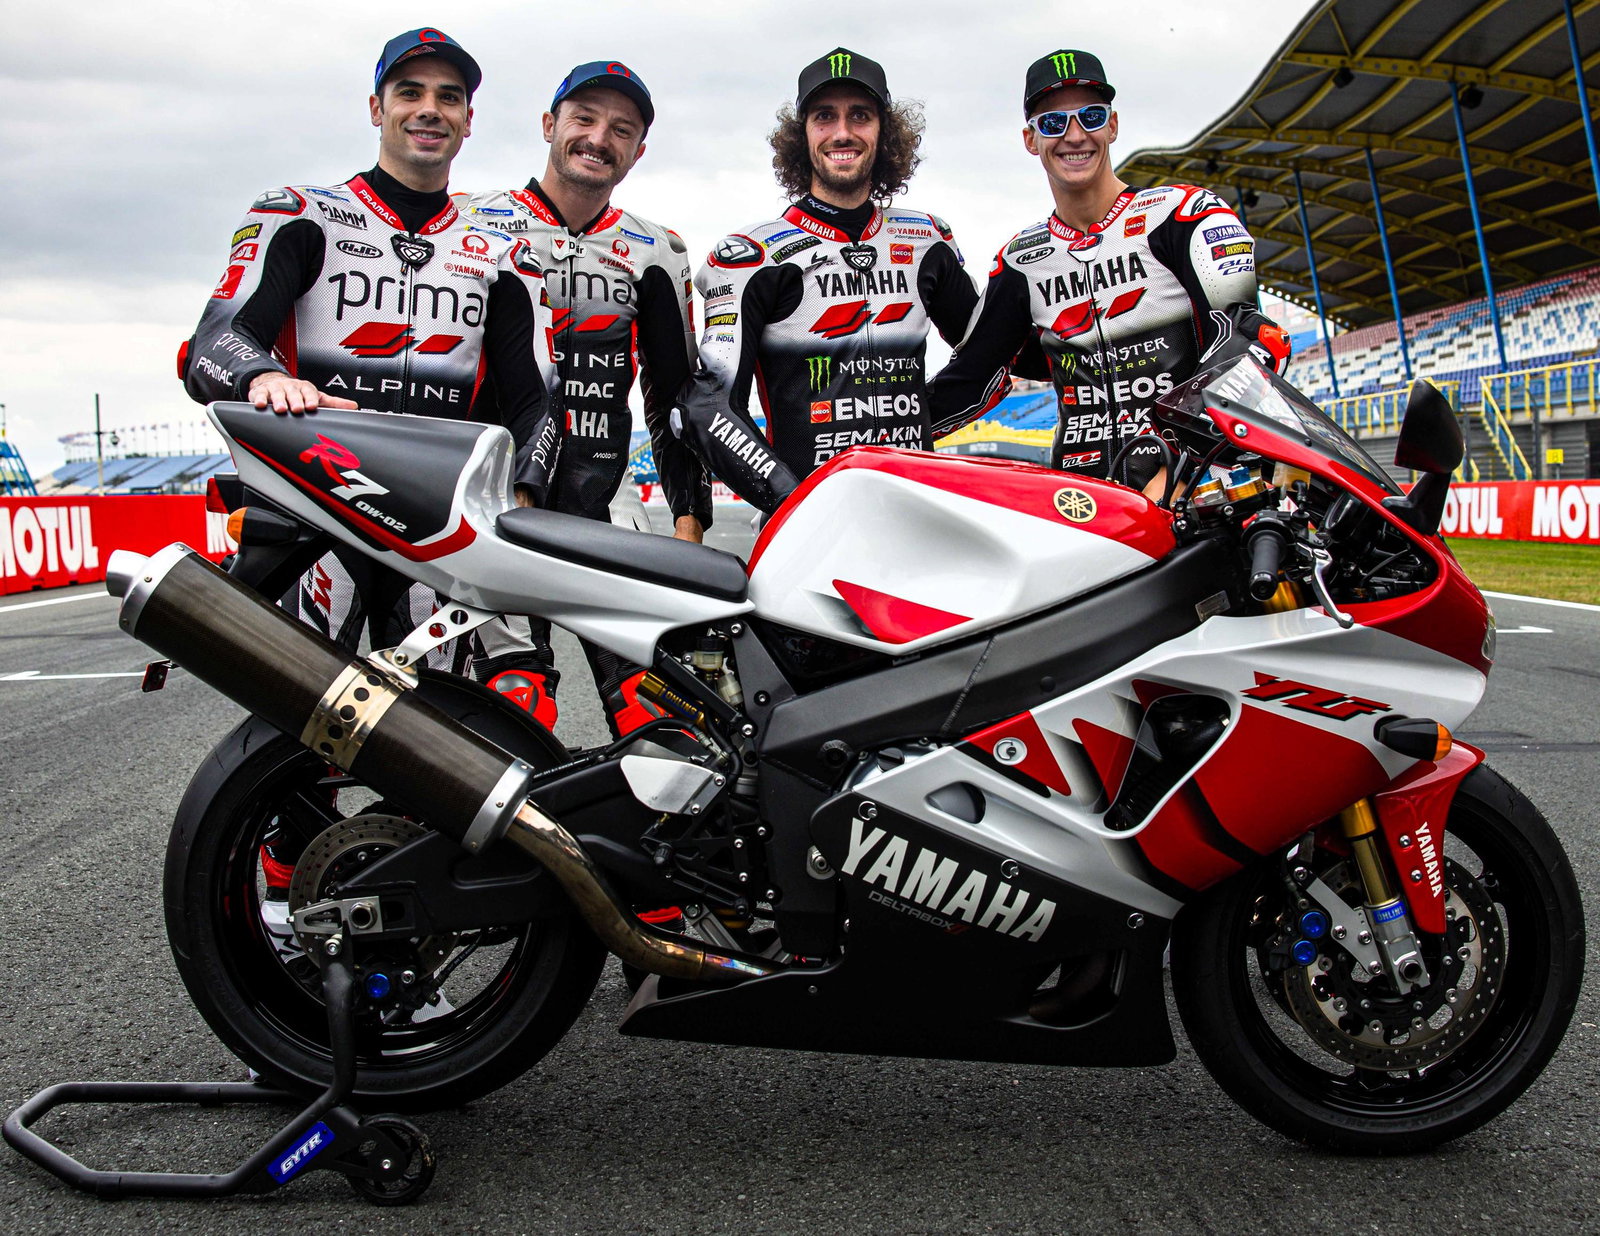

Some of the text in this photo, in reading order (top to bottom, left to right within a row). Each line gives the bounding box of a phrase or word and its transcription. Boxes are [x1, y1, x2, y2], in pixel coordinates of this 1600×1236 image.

[317, 201, 367, 229] FIAMM
[358, 188, 397, 224] PRAMAC
[1097, 196, 1130, 230] YAMAHA
[1135, 195, 1167, 208] YAMAHA
[487, 219, 529, 232] FIAMM
[799, 215, 837, 240] YAMAHA
[897, 227, 933, 238] YAMAHA
[1125, 222, 1145, 230] ENEOS
[341, 242, 378, 256] HJC
[451, 249, 497, 265] PRAMAC
[1021, 248, 1048, 262] HJC
[453, 263, 485, 279] YAMAHA
[607, 258, 635, 275] YAMAHA
[1036, 251, 1148, 307] YAMAHA
[543, 268, 632, 305] rima
[706, 284, 734, 300] MALUBE
[815, 269, 909, 298] YAMAHA
[328, 270, 483, 328] prima
[212, 333, 260, 361] prima
[552, 352, 625, 368] PINE
[1081, 337, 1170, 368] MONSTER
[197, 356, 233, 387] PRAMAC
[839, 356, 920, 376] MONSTER
[854, 375, 913, 385] ENERGY
[326, 373, 461, 403] ALPINE
[565, 380, 615, 399] MAC
[1077, 372, 1174, 405] ENEOS
[811, 408, 830, 416] ENEOS
[835, 393, 921, 421] ENEOS
[1066, 407, 1152, 431] SEMAK
[568, 408, 609, 439] AHA
[531, 417, 557, 470] prima
[707, 412, 777, 479] YAMAHA
[355, 500, 408, 533] OW-02
[1440, 486, 1503, 535] OTUL
[1531, 485, 1600, 540] MOT
[1415, 821, 1443, 898] YAMAHA
[841, 817, 1057, 943] YAMAHA
[868, 890, 954, 930] DELTABOX
[279, 1131, 324, 1175] GYTR
